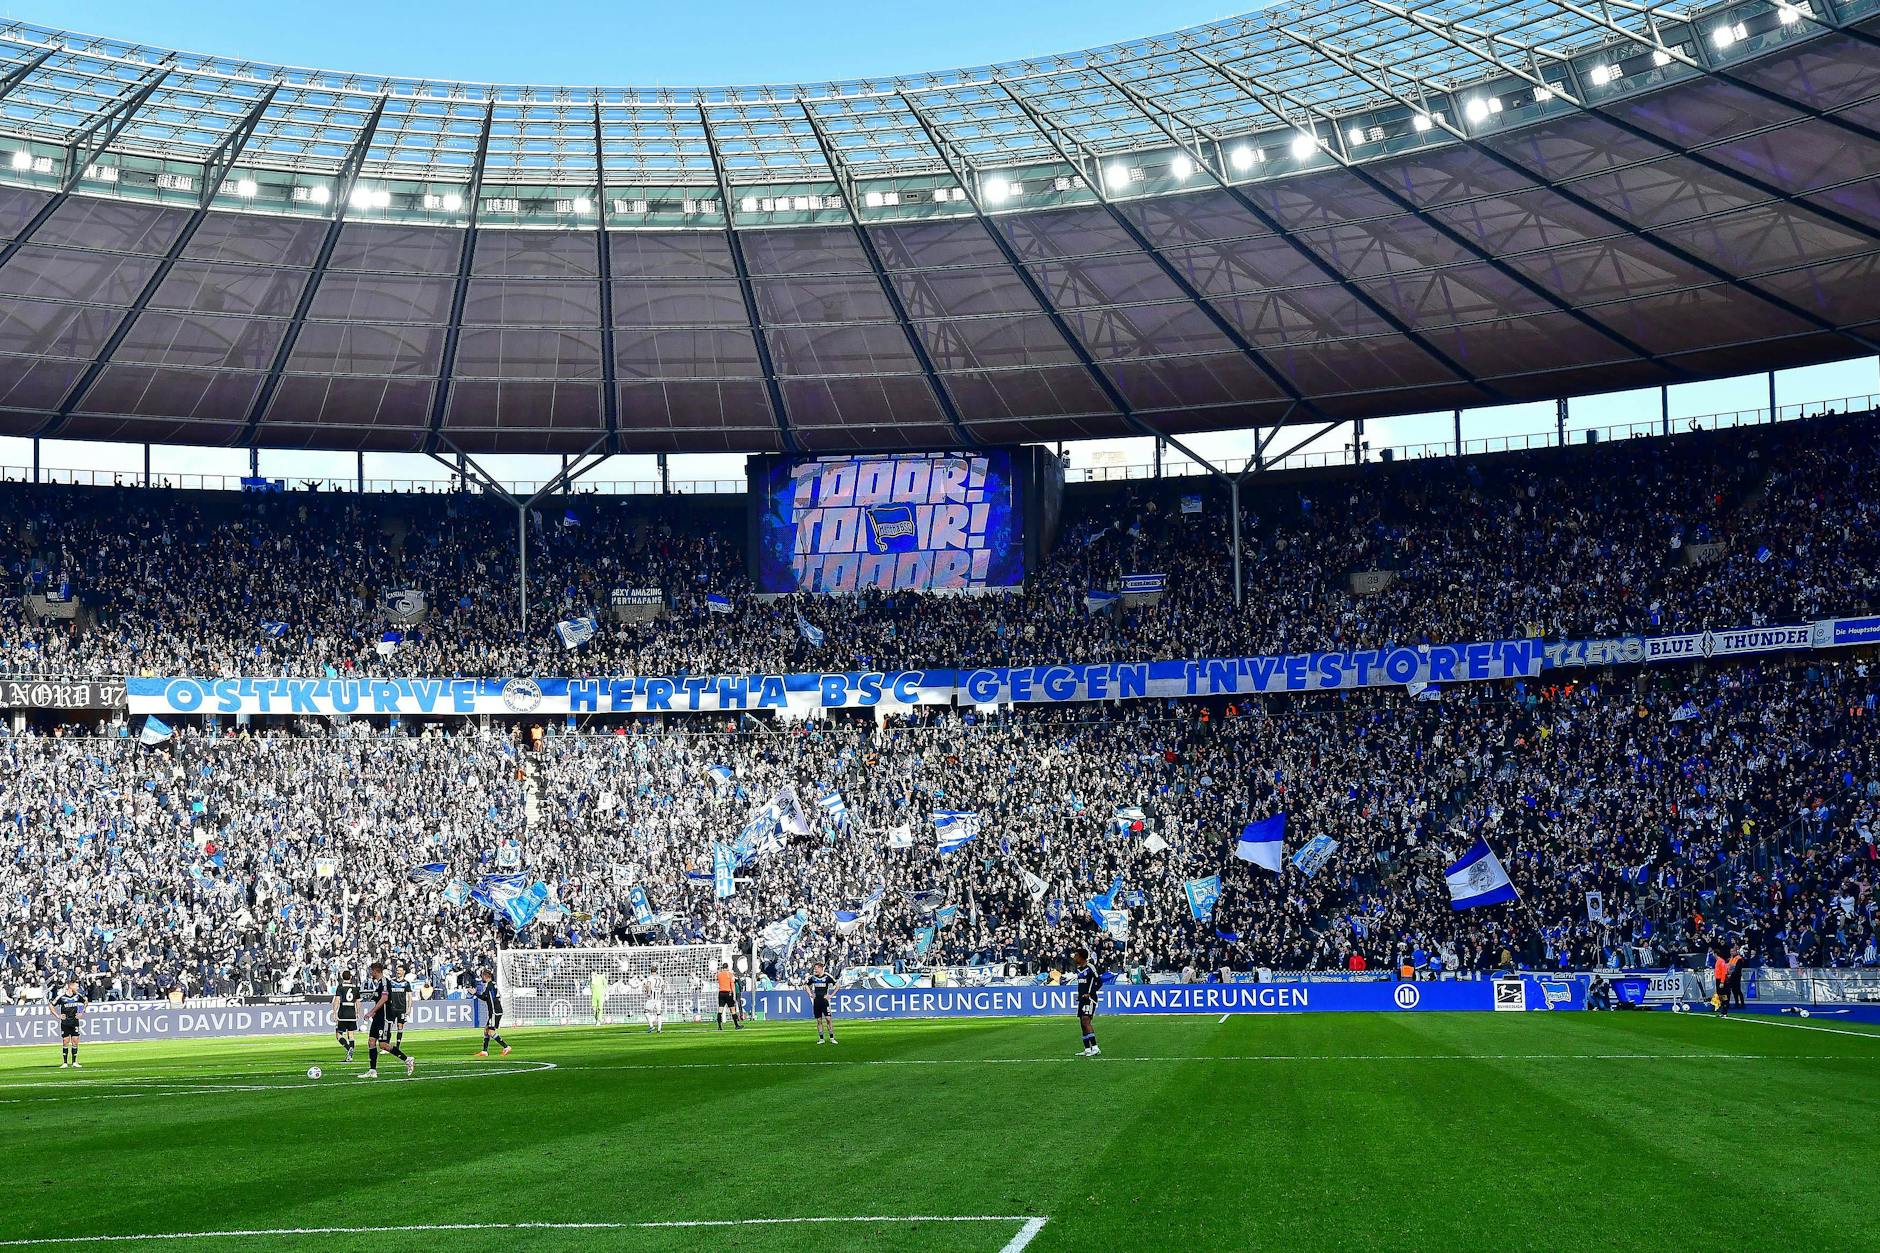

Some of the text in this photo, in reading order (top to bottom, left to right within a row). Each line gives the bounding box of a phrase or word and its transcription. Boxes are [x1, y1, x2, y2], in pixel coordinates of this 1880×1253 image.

[791, 458, 990, 507] TOOOR!
[791, 503, 990, 554] TOR!
[611, 588, 662, 597] SEXY AMAZING
[1368, 576, 1379, 585] 39
[1543, 638, 1646, 668] 71ERS
[1650, 639, 1694, 655] BLUE
[1723, 630, 1809, 649] THUNDER
[967, 640, 1534, 702] GEGEN INVESTOREN
[9, 682, 91, 708] NORD
[164, 671, 925, 713] OSTKURVE HERTHA BSC
[345, 987, 354, 1002] 6
[760, 996, 769, 1014] 1
[778, 996, 801, 1013] IN
[810, 991, 1022, 1014] ERSICHERUNGEN
[1095, 988, 1308, 1008] FINANZIERUNGEN
[0, 1015, 169, 1041] LVERRETUNG
[178, 1011, 252, 1032] DAVID
